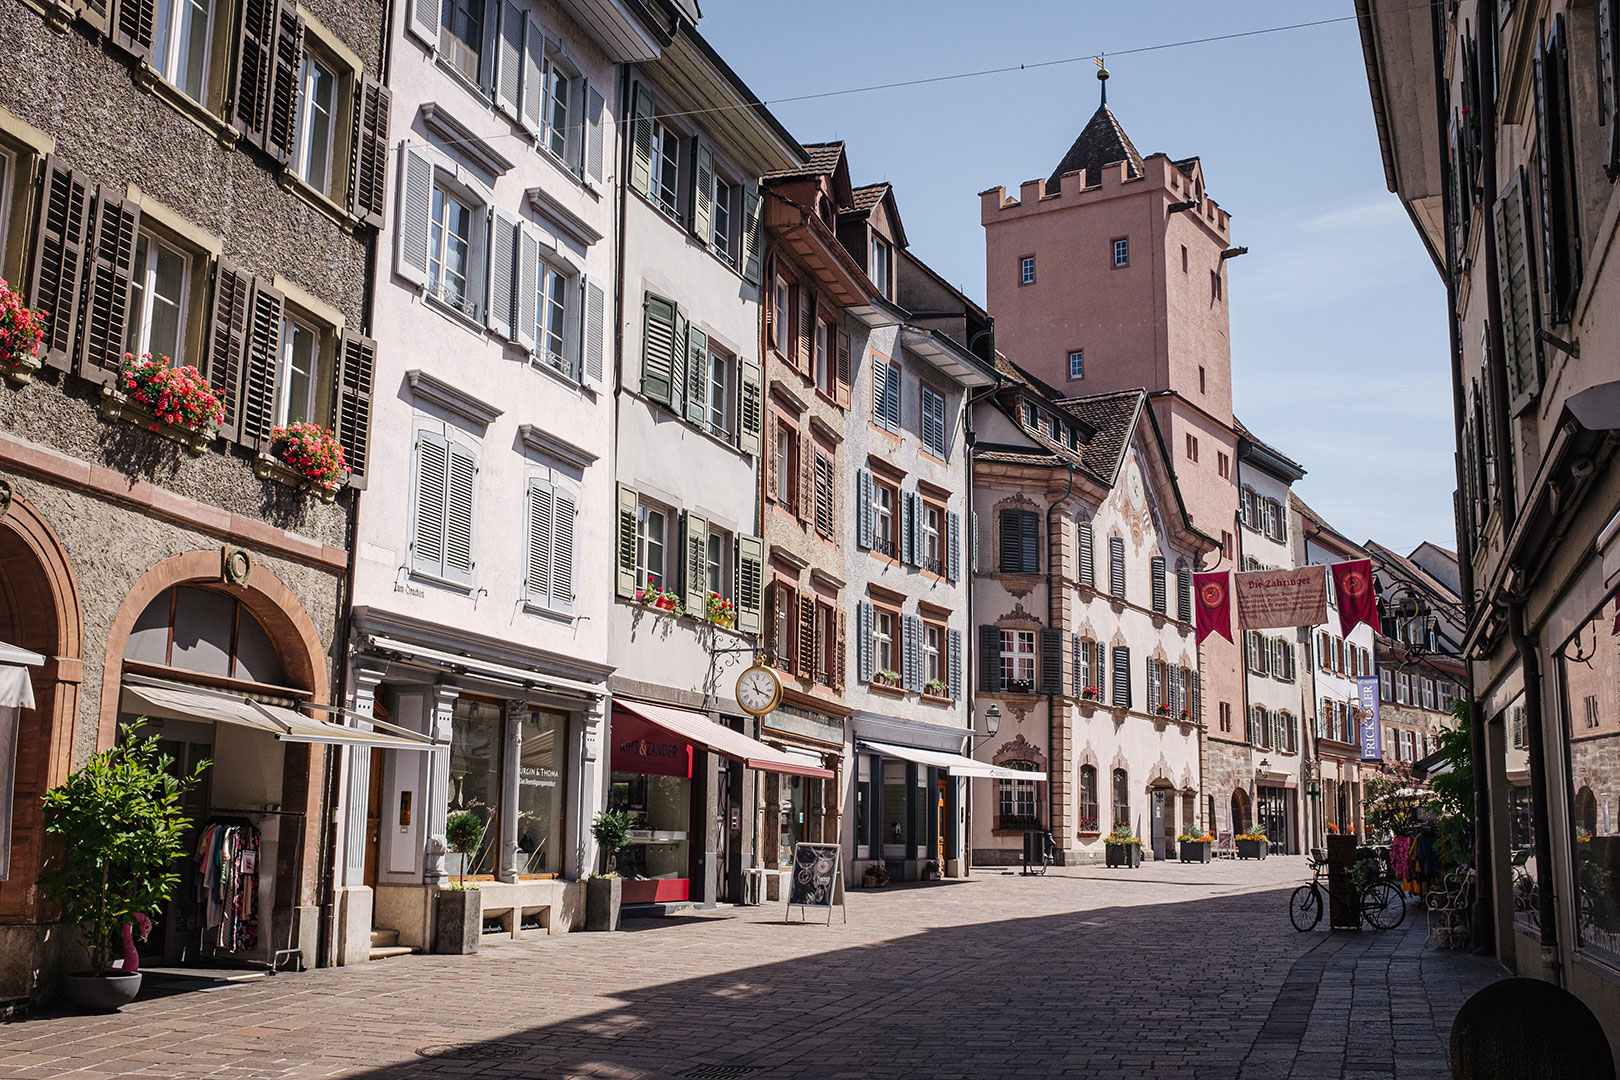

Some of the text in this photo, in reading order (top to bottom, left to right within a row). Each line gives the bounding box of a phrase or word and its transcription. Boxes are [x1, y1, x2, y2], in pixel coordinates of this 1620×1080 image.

[1248, 576, 1311, 589] Die Zähringer
[519, 765, 535, 775] ÜRGIN
